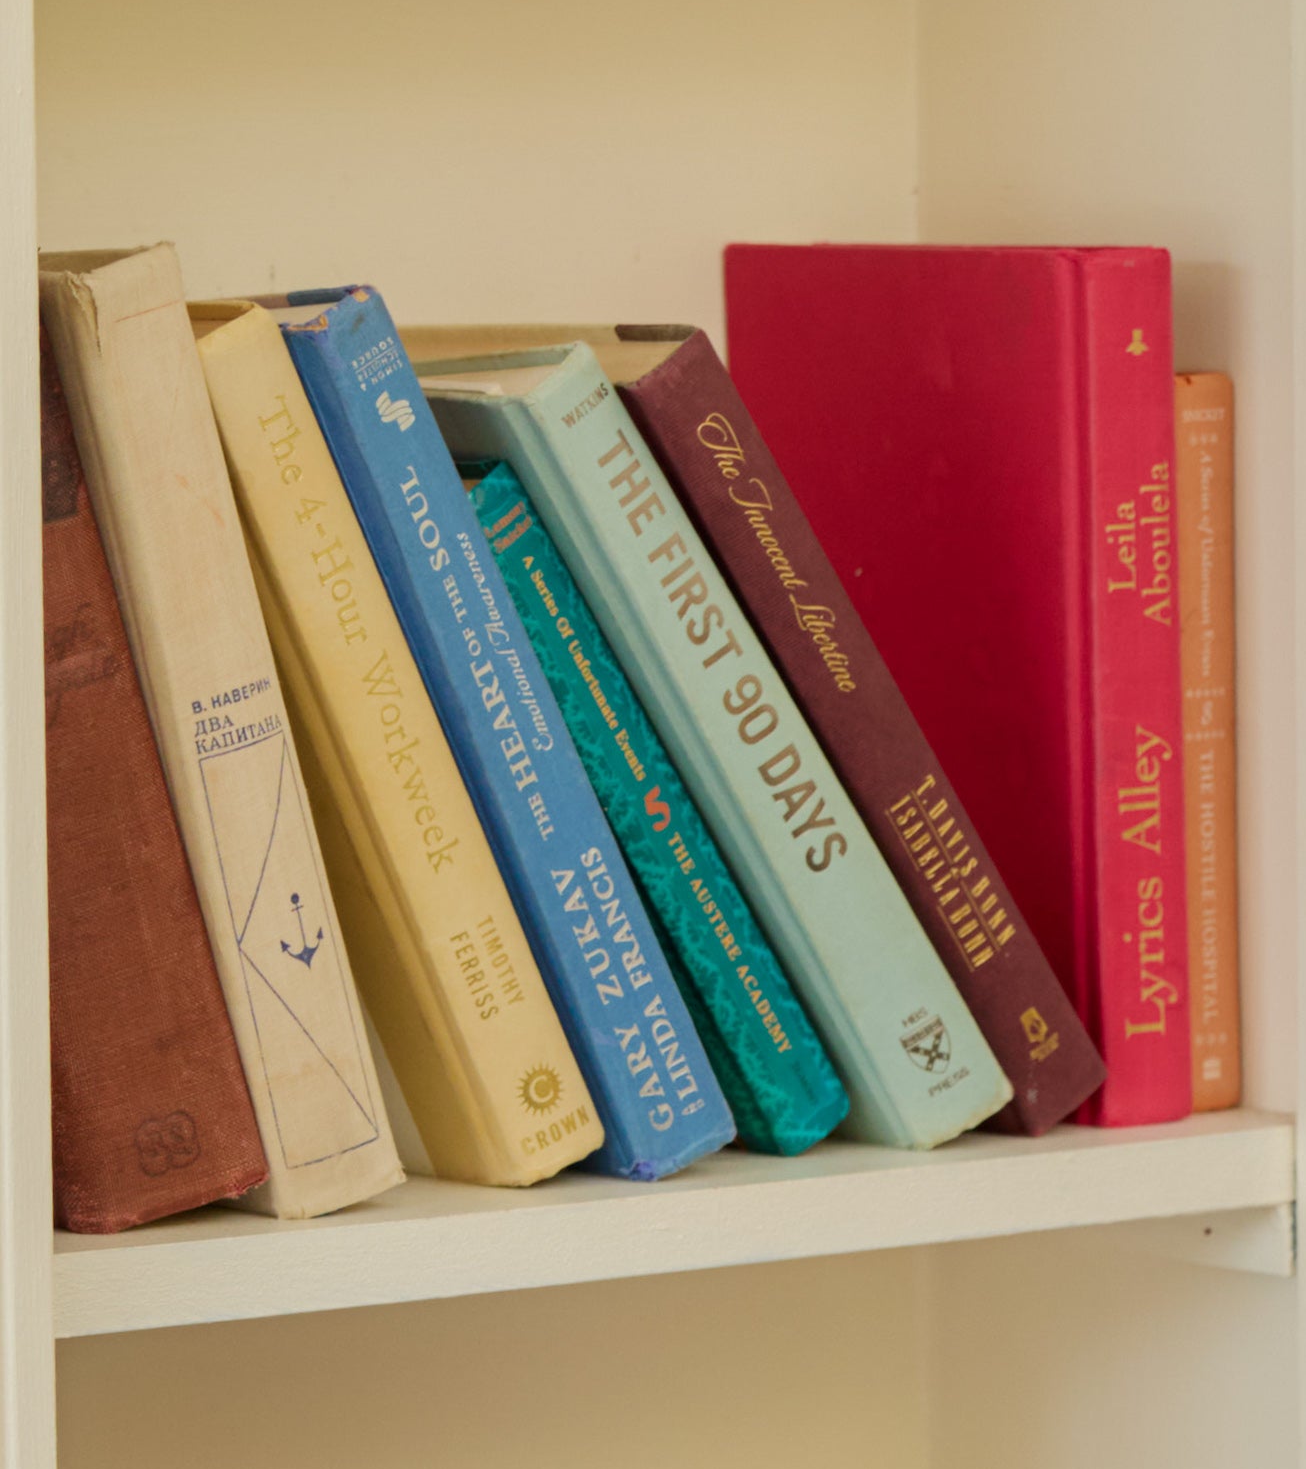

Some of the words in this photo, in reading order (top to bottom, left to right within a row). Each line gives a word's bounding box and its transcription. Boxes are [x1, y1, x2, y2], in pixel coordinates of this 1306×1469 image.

[560, 381, 610, 430] WATKINS
[400, 464, 452, 573] SOUL
[697, 412, 746, 481] The
[728, 477, 809, 591] Innocent
[789, 592, 858, 694] Libertine
[1105, 499, 1137, 594] Leila
[1139, 459, 1172, 628] Aboulela
[258, 393, 305, 487] The
[295, 494, 368, 648] 4-Hour
[360, 647, 461, 876] Workweek
[441, 573, 468, 625] THE
[456, 530, 512, 656] Awareness
[462, 625, 483, 659] OF
[506, 647, 556, 754] Emotional
[521, 555, 535, 571] A
[530, 568, 560, 618] Series
[555, 616, 576, 640] Of
[568, 639, 619, 731] Unfortunate
[613, 728, 647, 783] Events
[596, 428, 666, 538] THE
[647, 531, 745, 672] FIRST
[722, 672, 781, 747] 90
[757, 743, 850, 875] DAYS
[194, 714, 235, 738] ДВА
[194, 713, 283, 755] КАПИТАНА
[469, 659, 540, 794] HEART
[1199, 749, 1215, 794] THE
[526, 791, 556, 843] THE
[643, 784, 671, 832] 5
[916, 773, 938, 806] T.
[927, 797, 980, 878] DAVIS
[1117, 724, 1173, 856] Alley
[889, 793, 961, 908] ISABELLA
[948, 902, 995, 969] BUNN
[1200, 801, 1216, 901] HOSTILE
[476, 913, 526, 1007] TIMOTHY
[550, 868, 625, 1007] ZUKAV
[579, 845, 654, 992] FRANCIS
[667, 831, 697, 876] THE
[689, 878, 743, 963] AUSTERE
[736, 964, 793, 1055] ACADEMY
[1123, 875, 1179, 1042] Lyrics
[1201, 907, 1219, 1024] HOSPITAL
[449, 930, 500, 1022] FERRISS
[614, 1022, 676, 1132] GARY
[643, 993, 699, 1102] LINDA
[520, 1104, 590, 1158] CROWN
